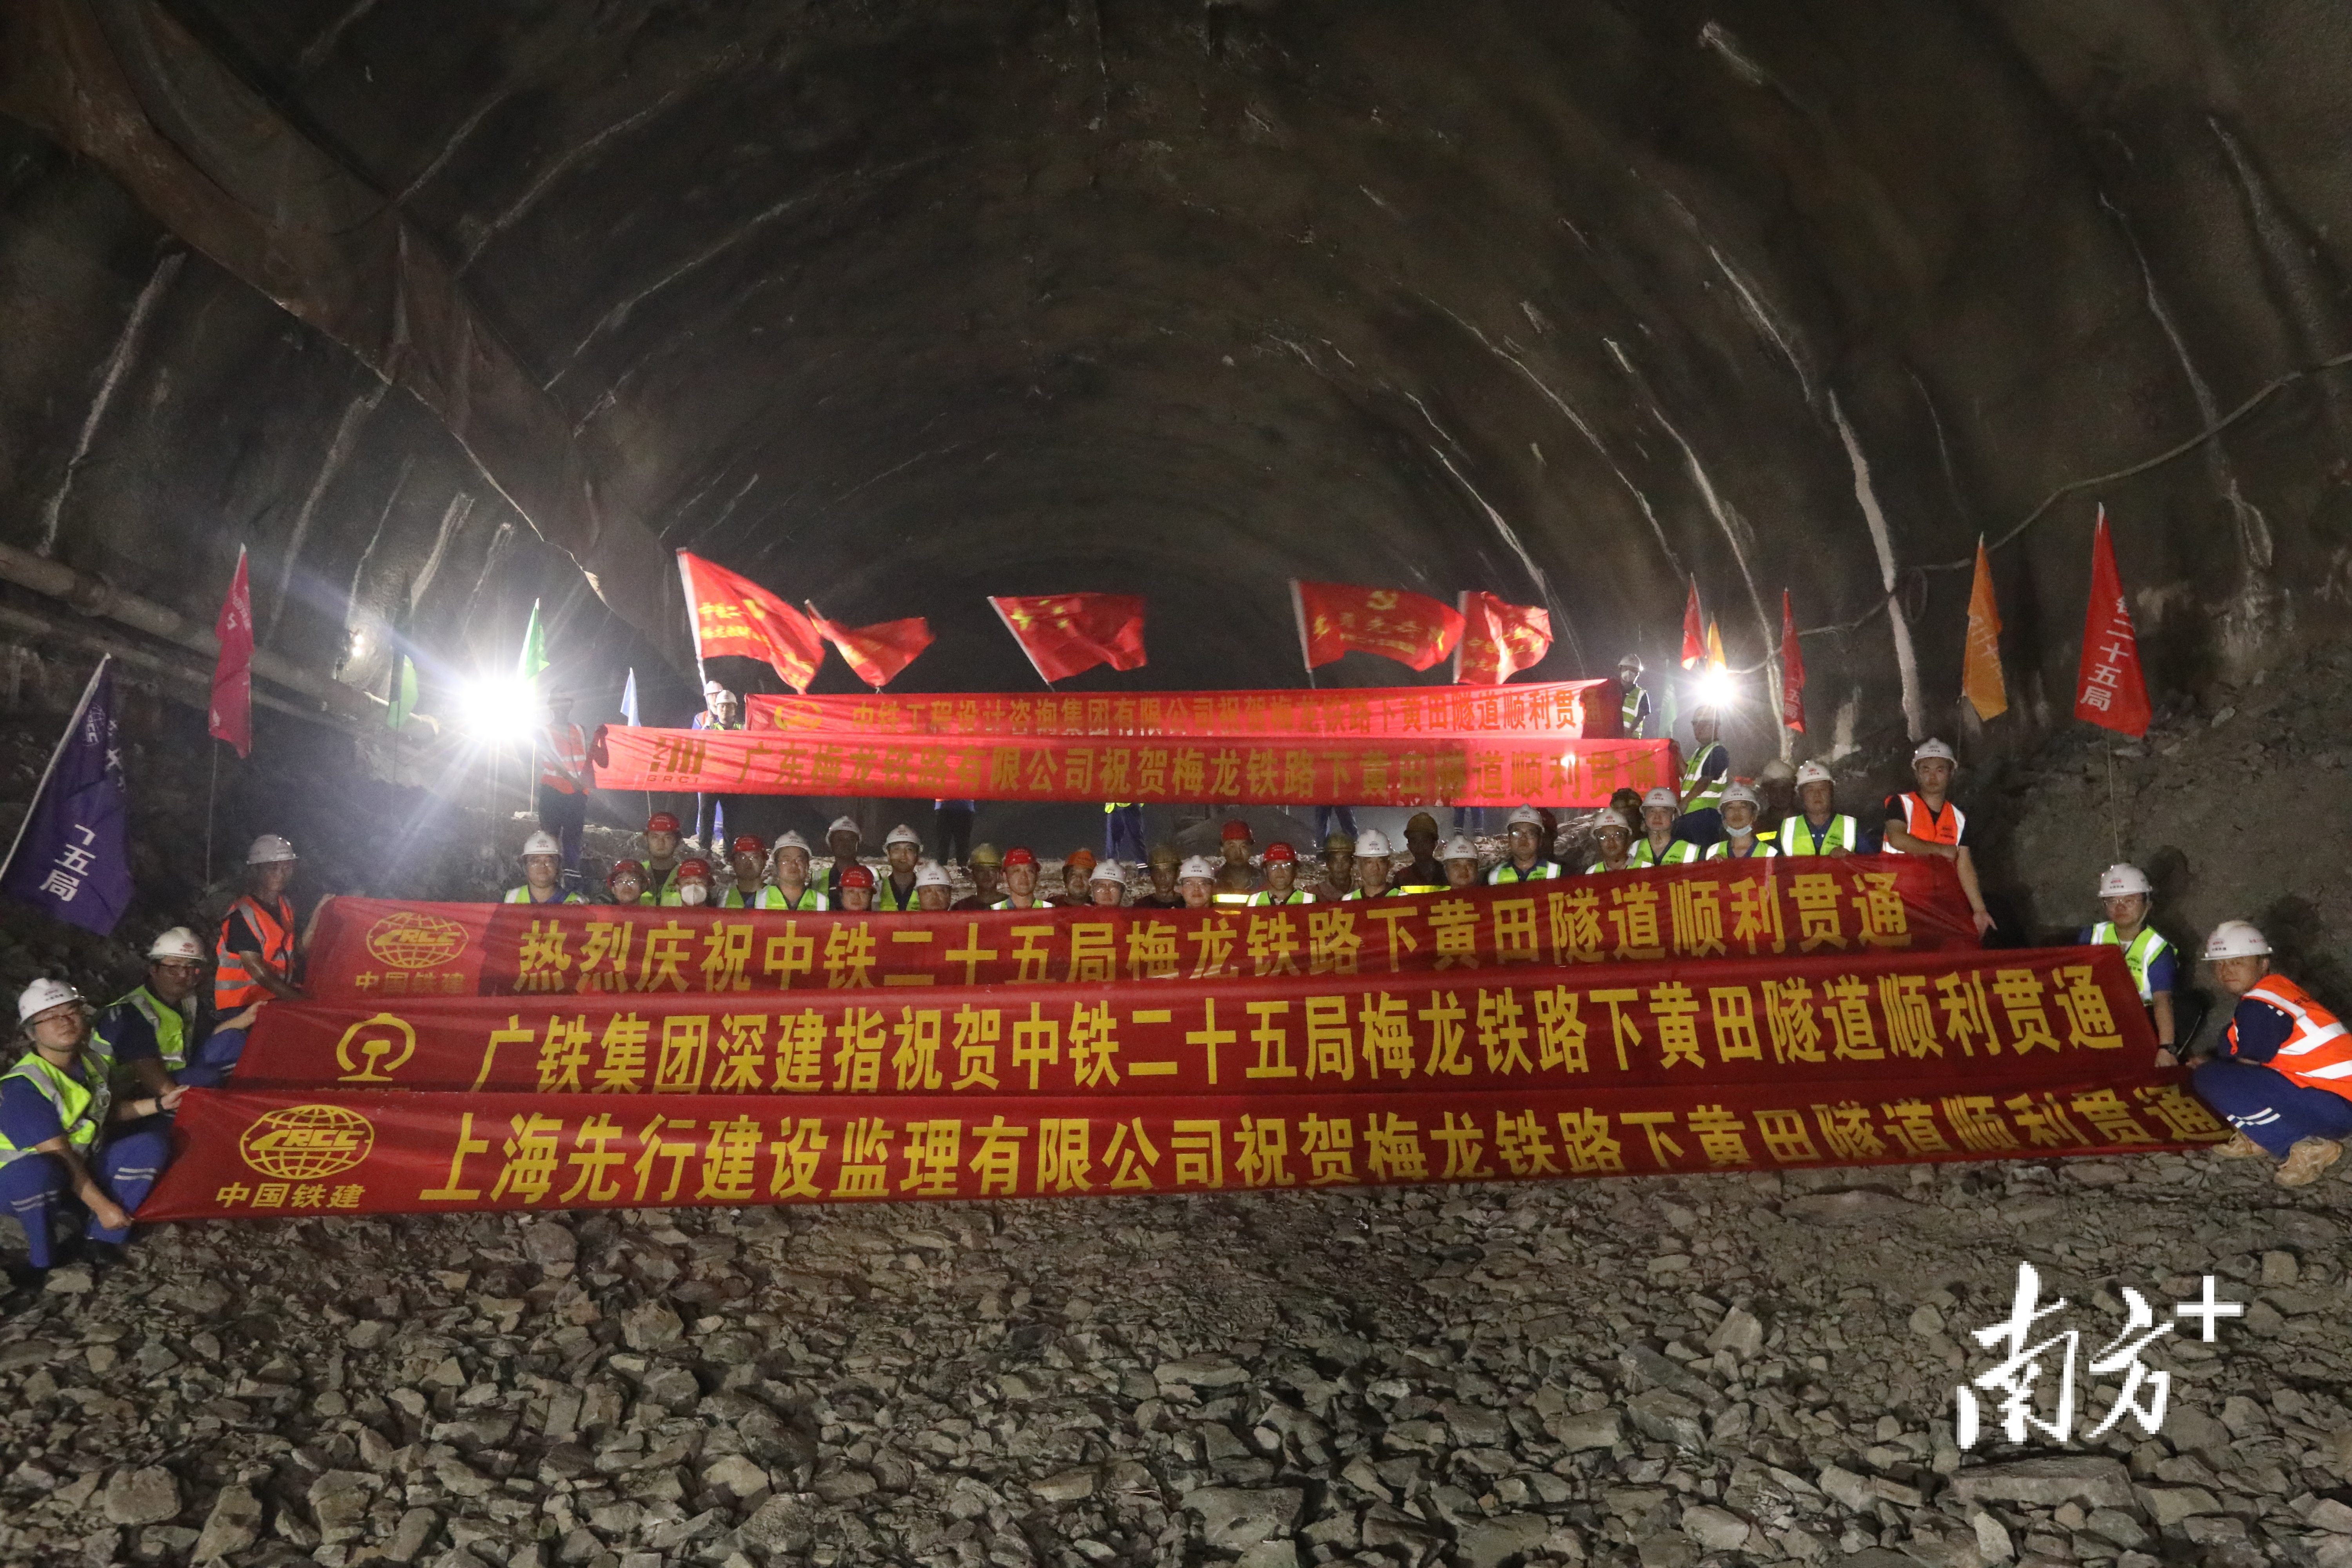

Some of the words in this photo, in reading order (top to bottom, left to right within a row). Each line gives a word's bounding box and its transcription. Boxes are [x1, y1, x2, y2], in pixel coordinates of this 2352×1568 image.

[736, 741, 1657, 800] 广东梅龙铁路有限公司祝贺梅龙铁路下黄田隧道顺利贯通
[374, 928, 461, 946] CRCC
[513, 872, 1912, 993] 热烈庆祝中铁二十五局梅龙铁路下黄田隧道顺利贯通
[354, 970, 466, 994] 中国铁建
[472, 966, 2123, 1094] 广铁集团深建指祝贺中铁二十五局梅龙铁路下黄田隧道顺利贯通
[248, 1128, 365, 1151] CRCC
[419, 1085, 2234, 1204] 上海先行建设监理有限公司祝贺梅龙铁路下黄田隧道顺利贯通
[215, 1181, 365, 1209] 中国铁建
